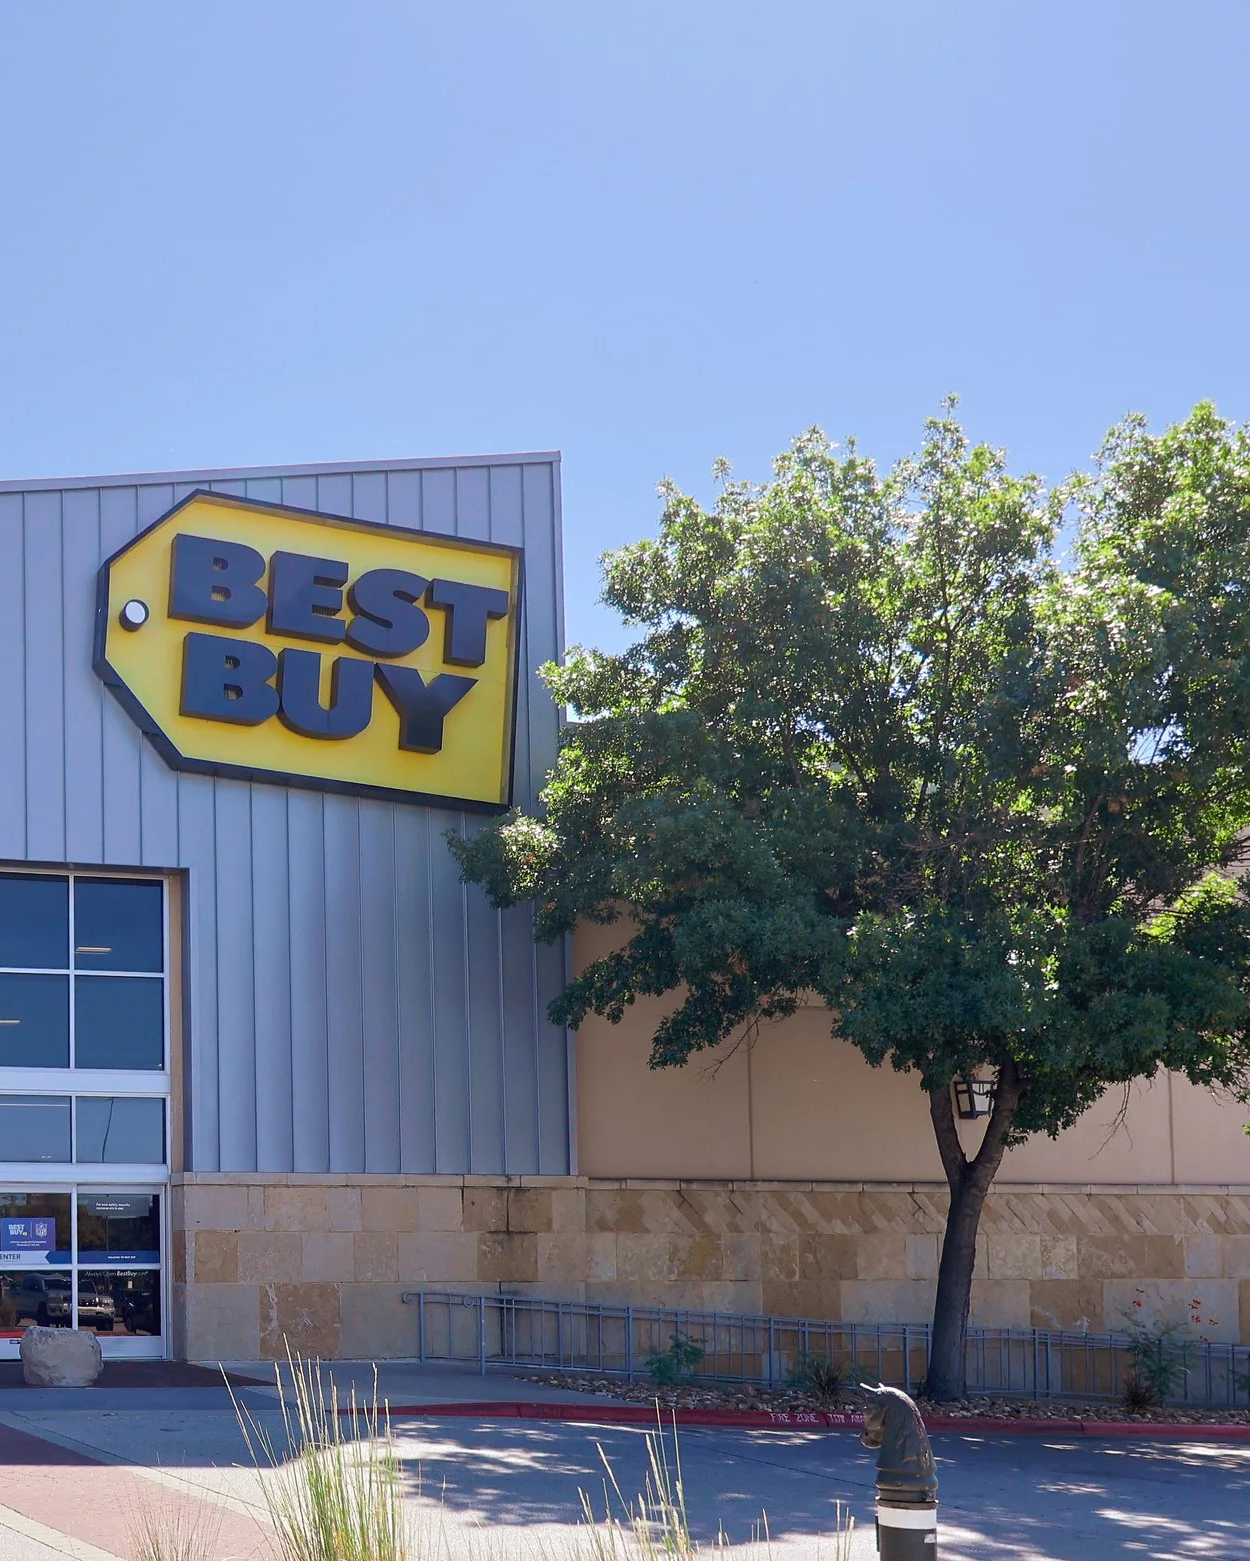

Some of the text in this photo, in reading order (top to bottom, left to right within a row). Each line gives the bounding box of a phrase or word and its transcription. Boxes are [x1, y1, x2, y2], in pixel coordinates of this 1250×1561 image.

[167, 533, 509, 669] BEST
[178, 632, 479, 755] BUY
[770, 1413, 790, 1423] FIRE
[793, 1413, 819, 1423] ZONE
[827, 1413, 845, 1423] TOW
